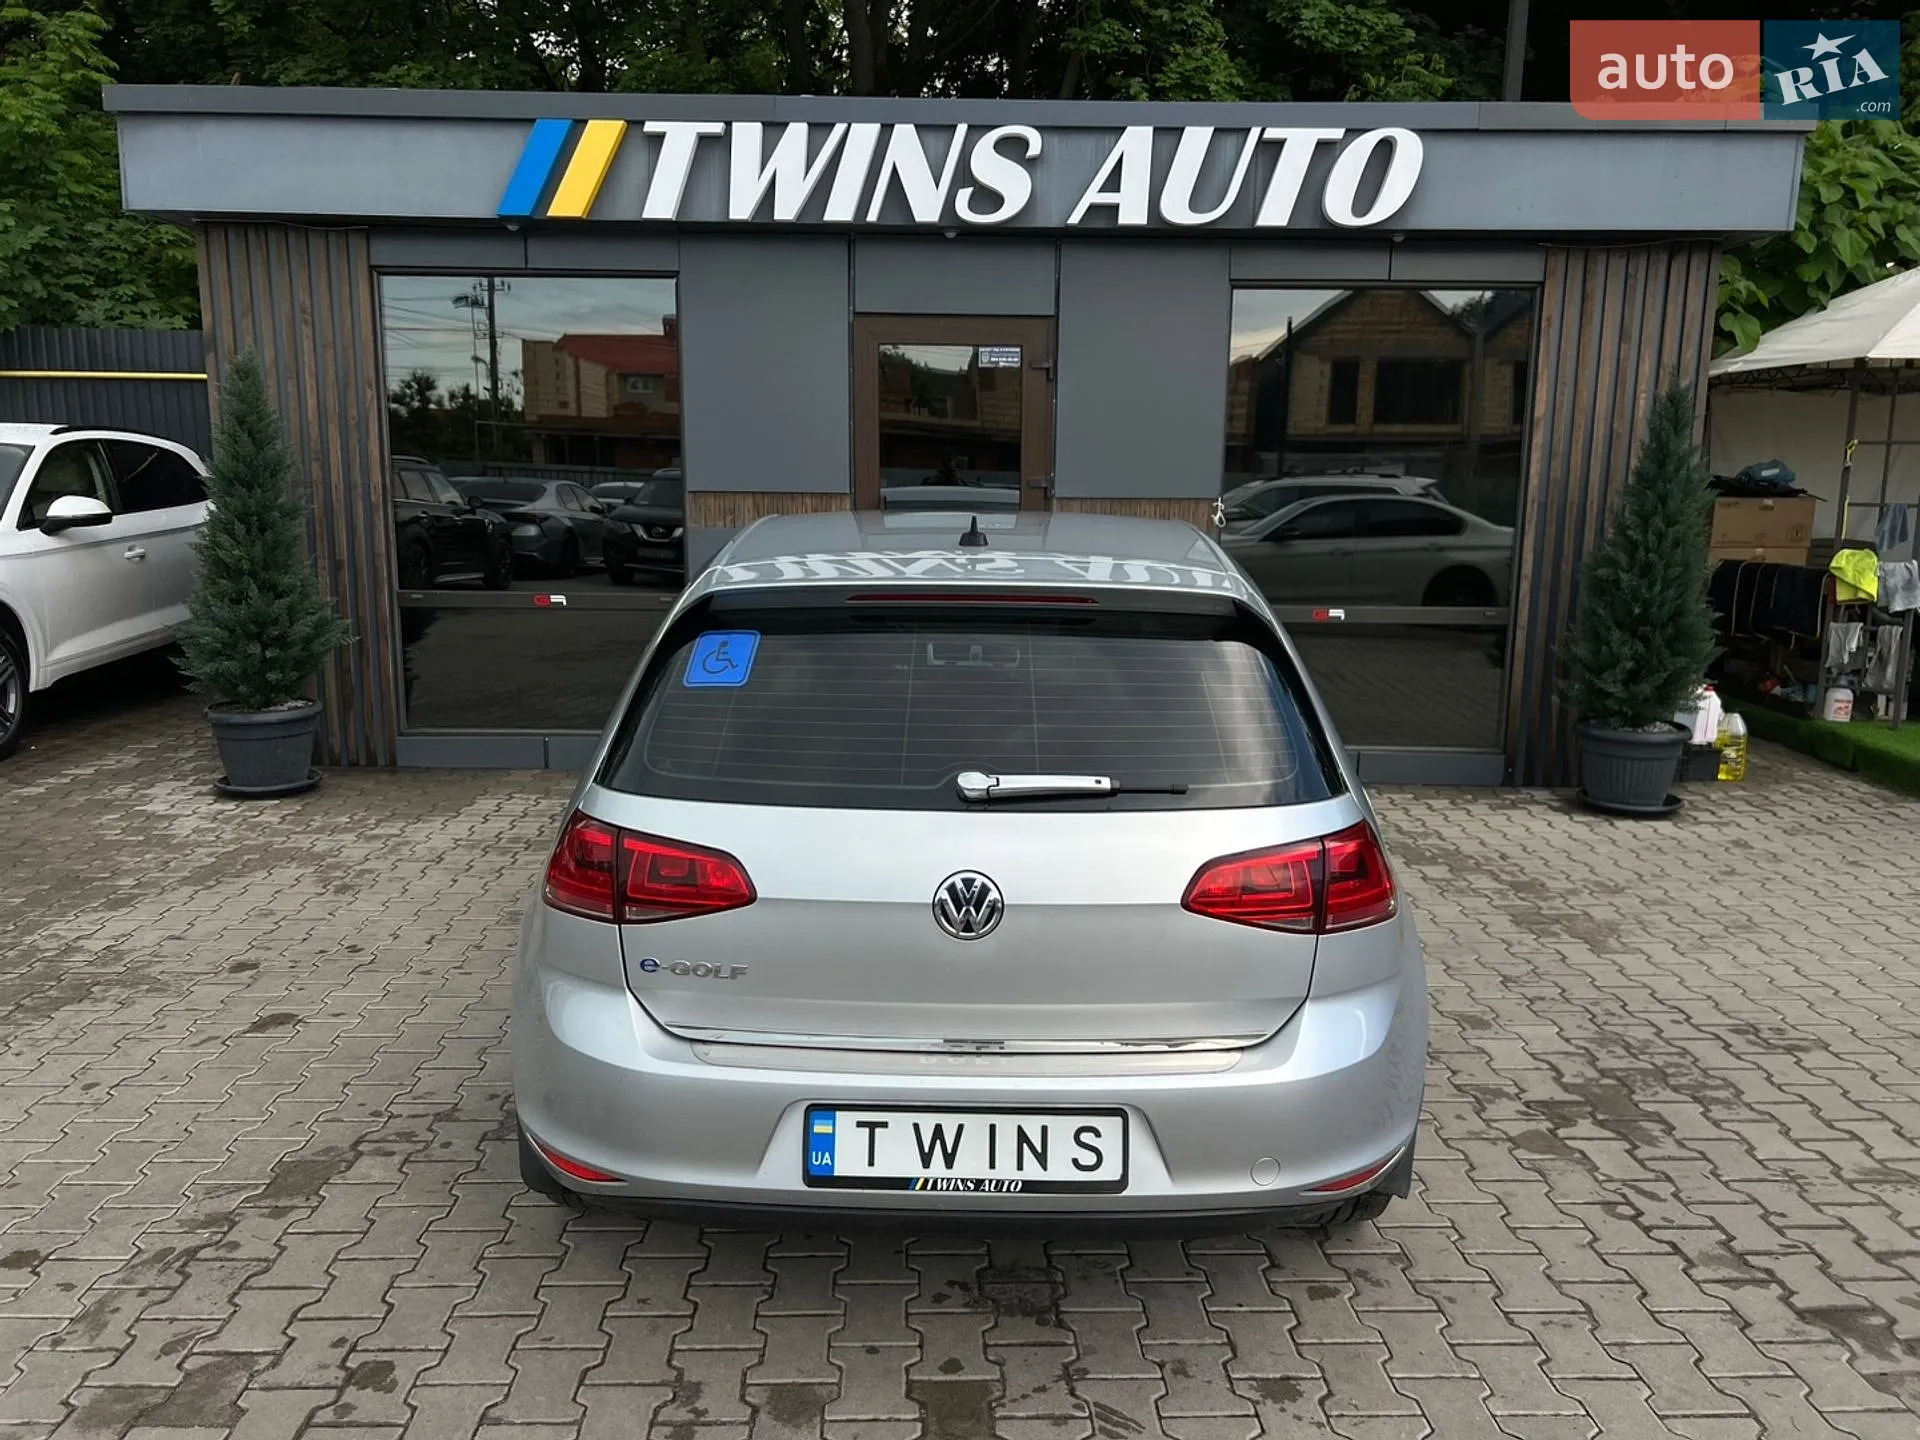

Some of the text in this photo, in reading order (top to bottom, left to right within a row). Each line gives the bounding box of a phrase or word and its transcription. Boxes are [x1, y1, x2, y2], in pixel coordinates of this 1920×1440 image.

[641, 121, 1424, 228] TWINS AUTO
[640, 957, 748, 980] e-GOLF
[855, 1119, 1105, 1173] TWINS
[812, 1151, 832, 1166] UA
[926, 1177, 1023, 1193] TWINS AUTO
